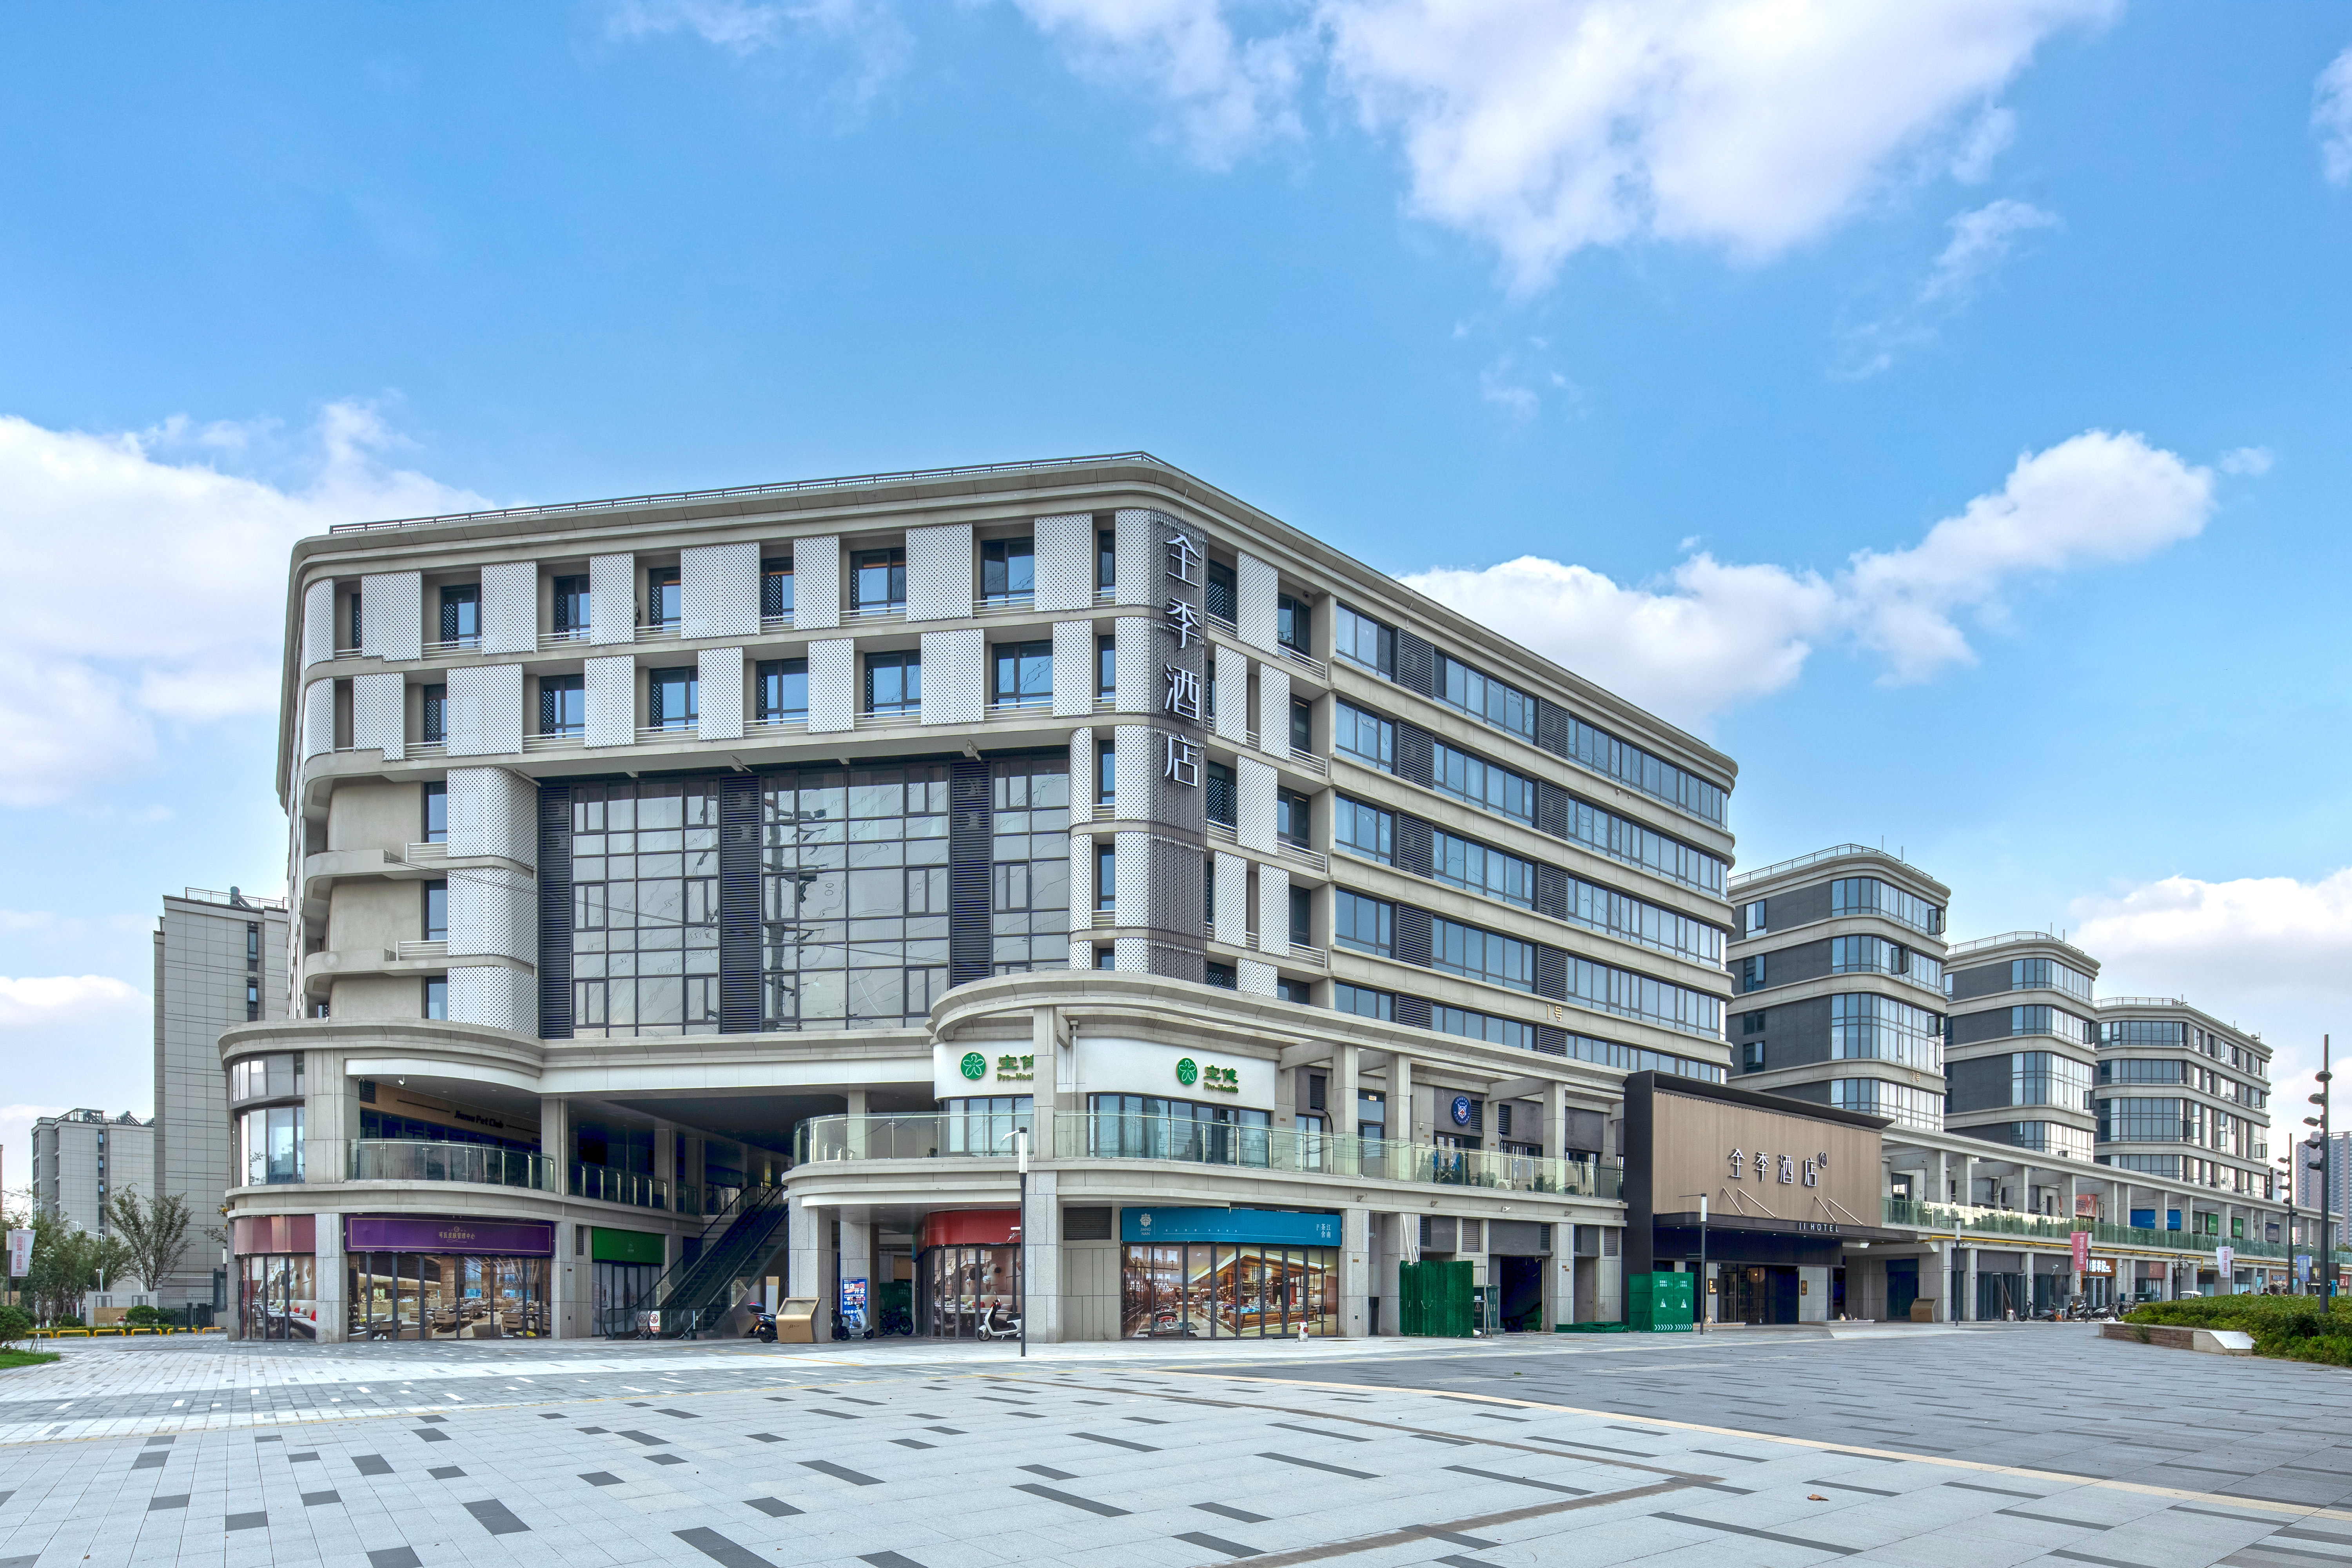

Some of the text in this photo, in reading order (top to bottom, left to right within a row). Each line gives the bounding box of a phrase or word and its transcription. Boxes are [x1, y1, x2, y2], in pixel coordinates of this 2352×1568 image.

[1164, 533, 1202, 788] 全季酒店
[1546, 1004, 1563, 1022] 1号
[997, 1073, 1034, 1081] Pro-Heal
[1203, 1065, 1238, 1083] 宝健
[1911, 1071, 1920, 1083] 2号
[1203, 1082, 1239, 1094] Pro-Health
[454, 1110, 504, 1129] Jiumu Pet Club
[1731, 1148, 1817, 1187] 全季酒店
[1799, 1222, 1839, 1232] JI HOTEL
